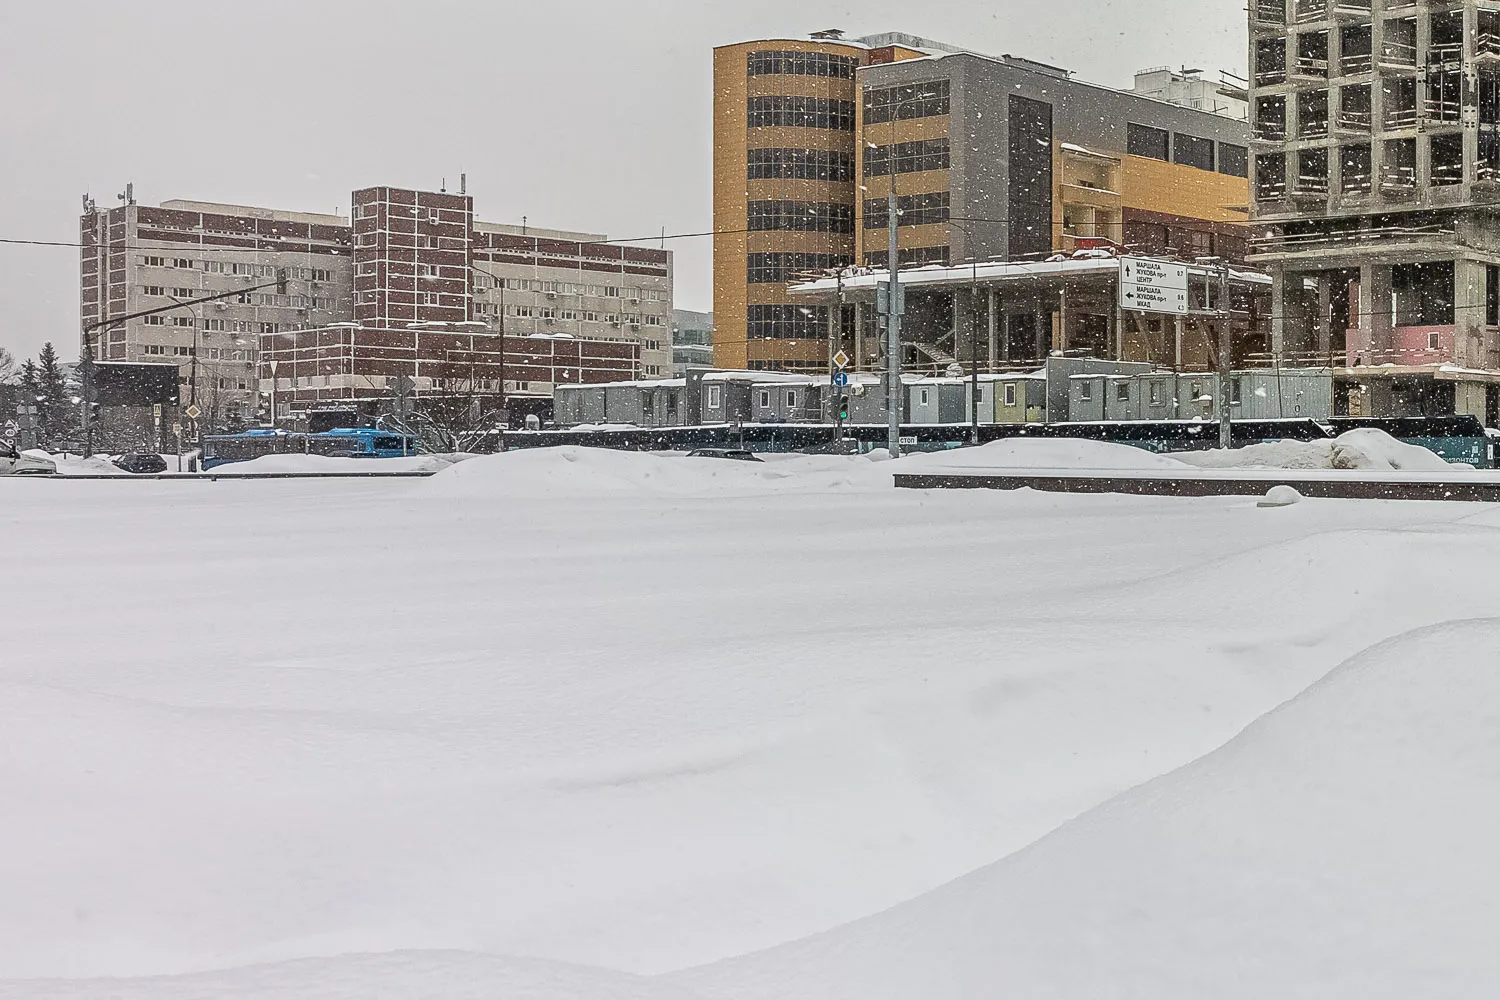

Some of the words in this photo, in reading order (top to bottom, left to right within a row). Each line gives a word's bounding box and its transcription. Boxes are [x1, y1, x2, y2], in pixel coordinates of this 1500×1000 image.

[1136, 262, 1161, 270] МАРШАЛА
[1136, 269, 1156, 277] ЖУКОВА
[1136, 286, 1161, 294] МАРШАЛА
[1136, 293, 1156, 301] ЖУКОВА
